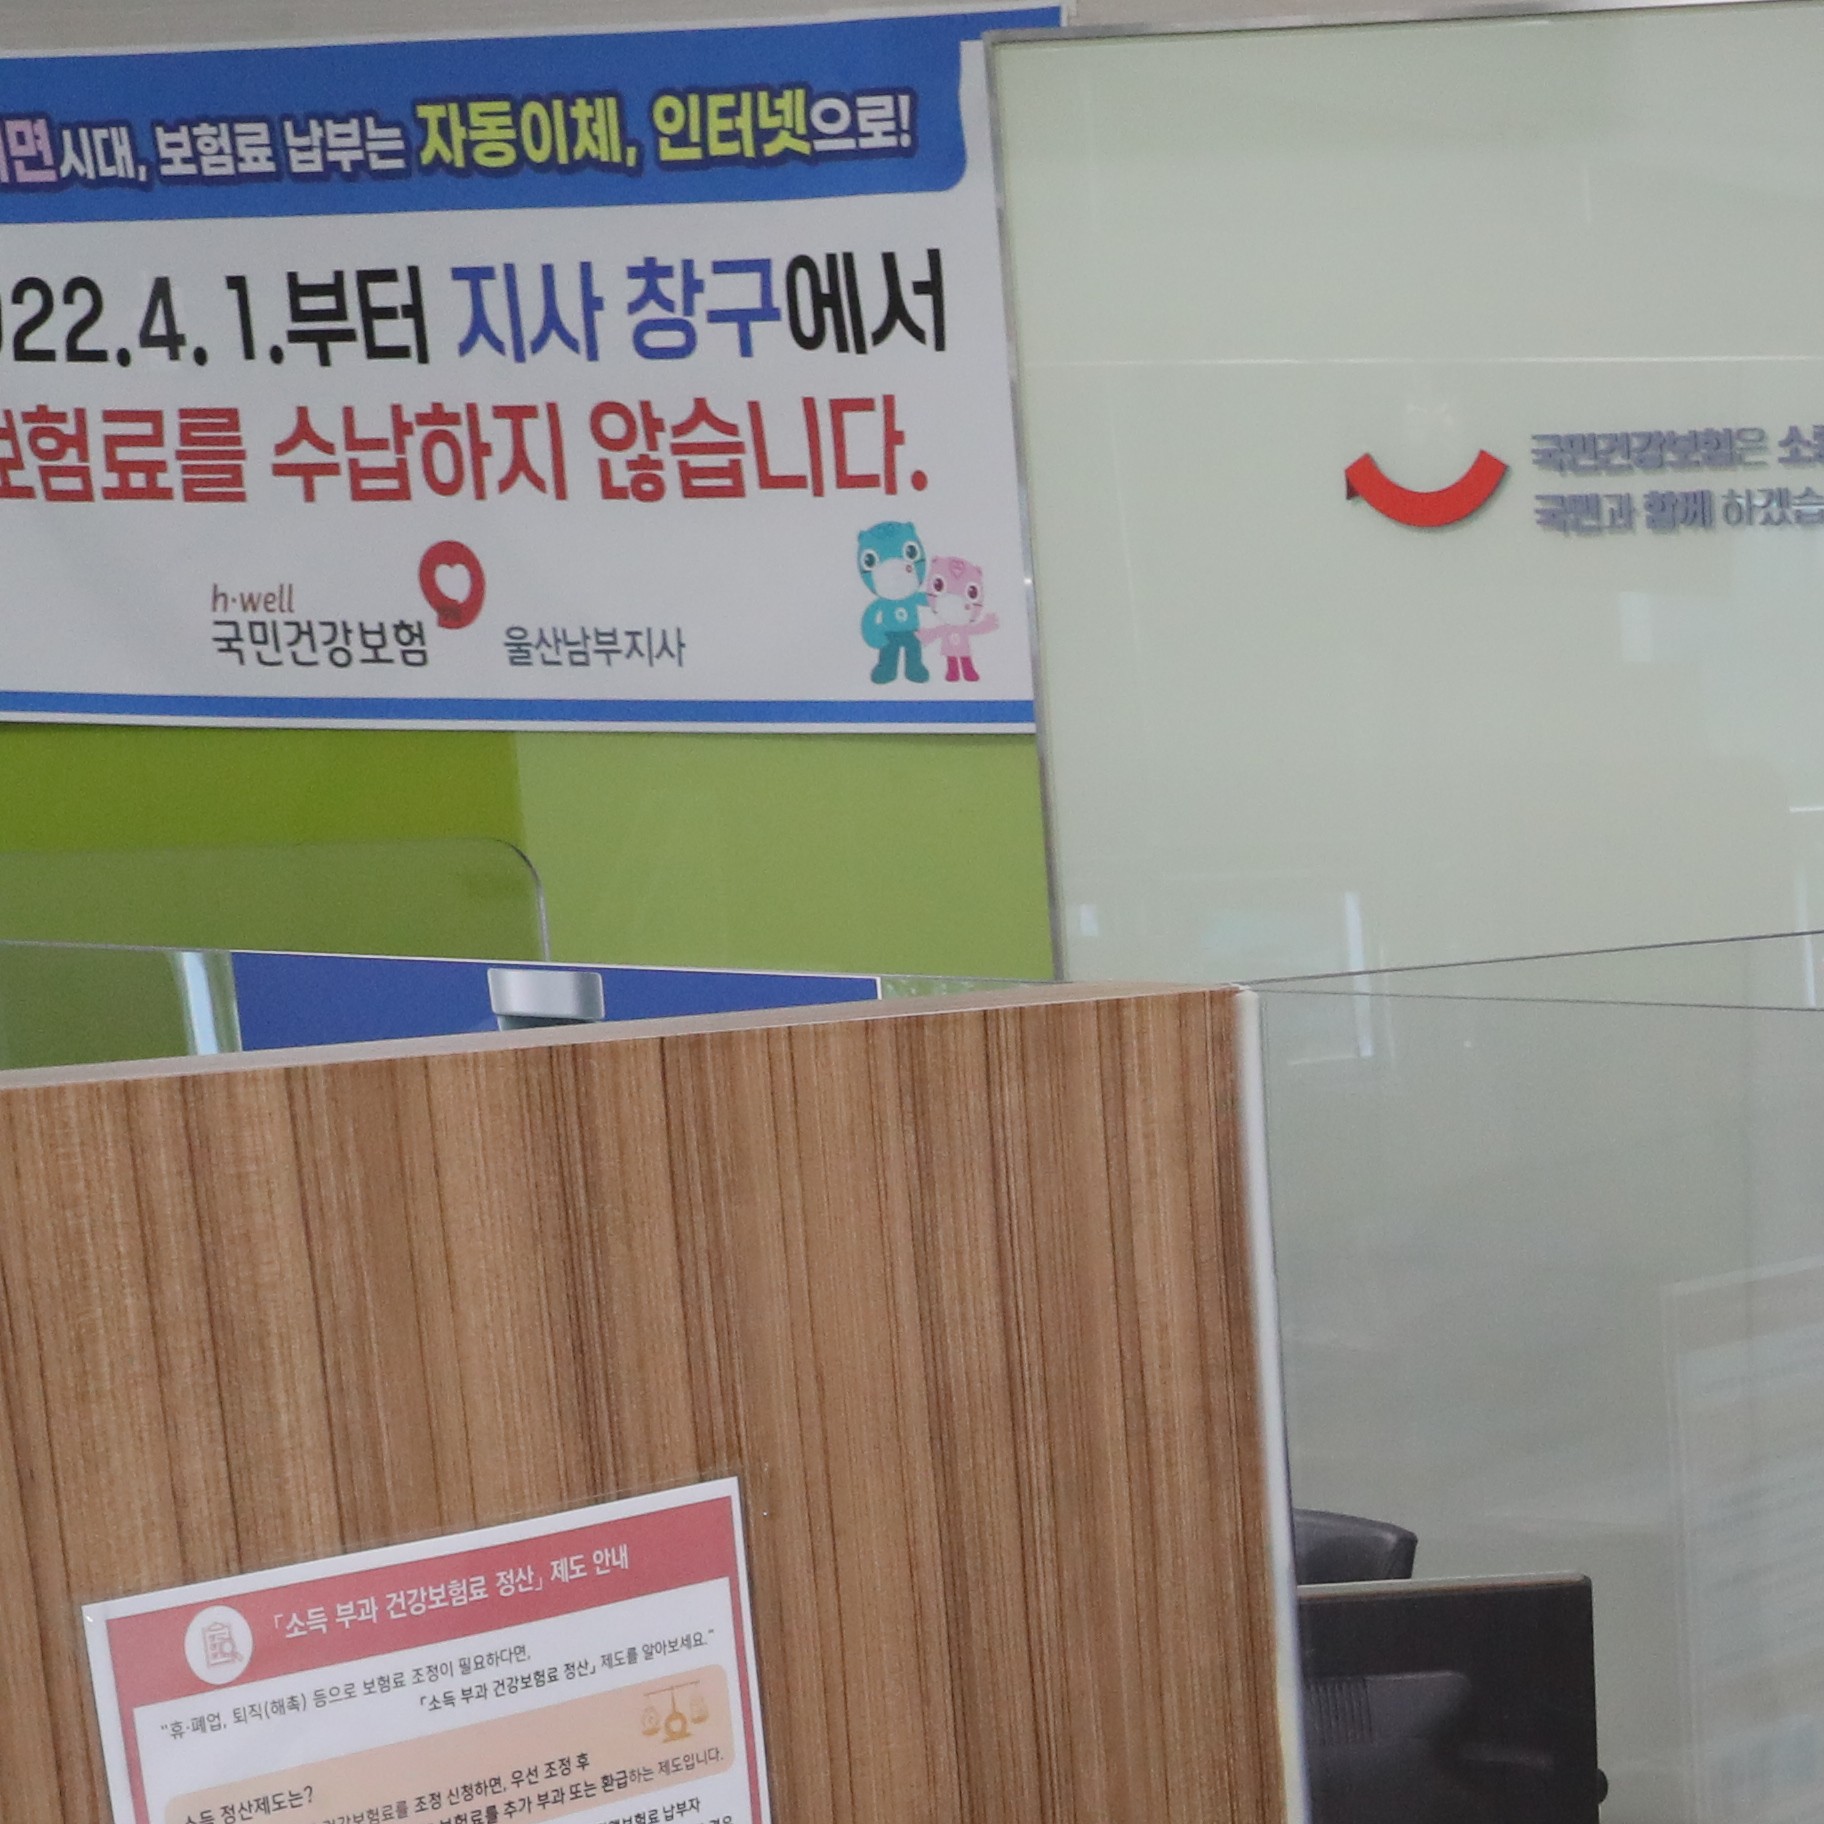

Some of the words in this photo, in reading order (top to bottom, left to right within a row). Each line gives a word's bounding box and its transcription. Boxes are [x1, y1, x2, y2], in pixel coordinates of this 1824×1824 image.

[0, 119, 146, 182] 면시대,
[156, 123, 275, 175] 보험료
[284, 117, 405, 172] 납부는
[417, 97, 636, 167] 자동이체,
[653, 89, 910, 160] 인터넷으로!
[0, 266, 429, 367] 22.4.1.부터
[451, 262, 603, 363] 지사
[627, 249, 945, 359] 창구에서
[272, 402, 567, 502] 수납하지
[590, 395, 927, 502] 않습니다.
[213, 620, 427, 668] 국민건강보험
[504, 626, 685, 666] 울산남부지사
[336, 1597, 378, 1628] 부과
[386, 1576, 488, 1618] 건강보험료
[551, 1555, 587, 1582] 제도
[593, 1544, 628, 1575] 안내
[221, 1786, 312, 1824] 정산제도는?
